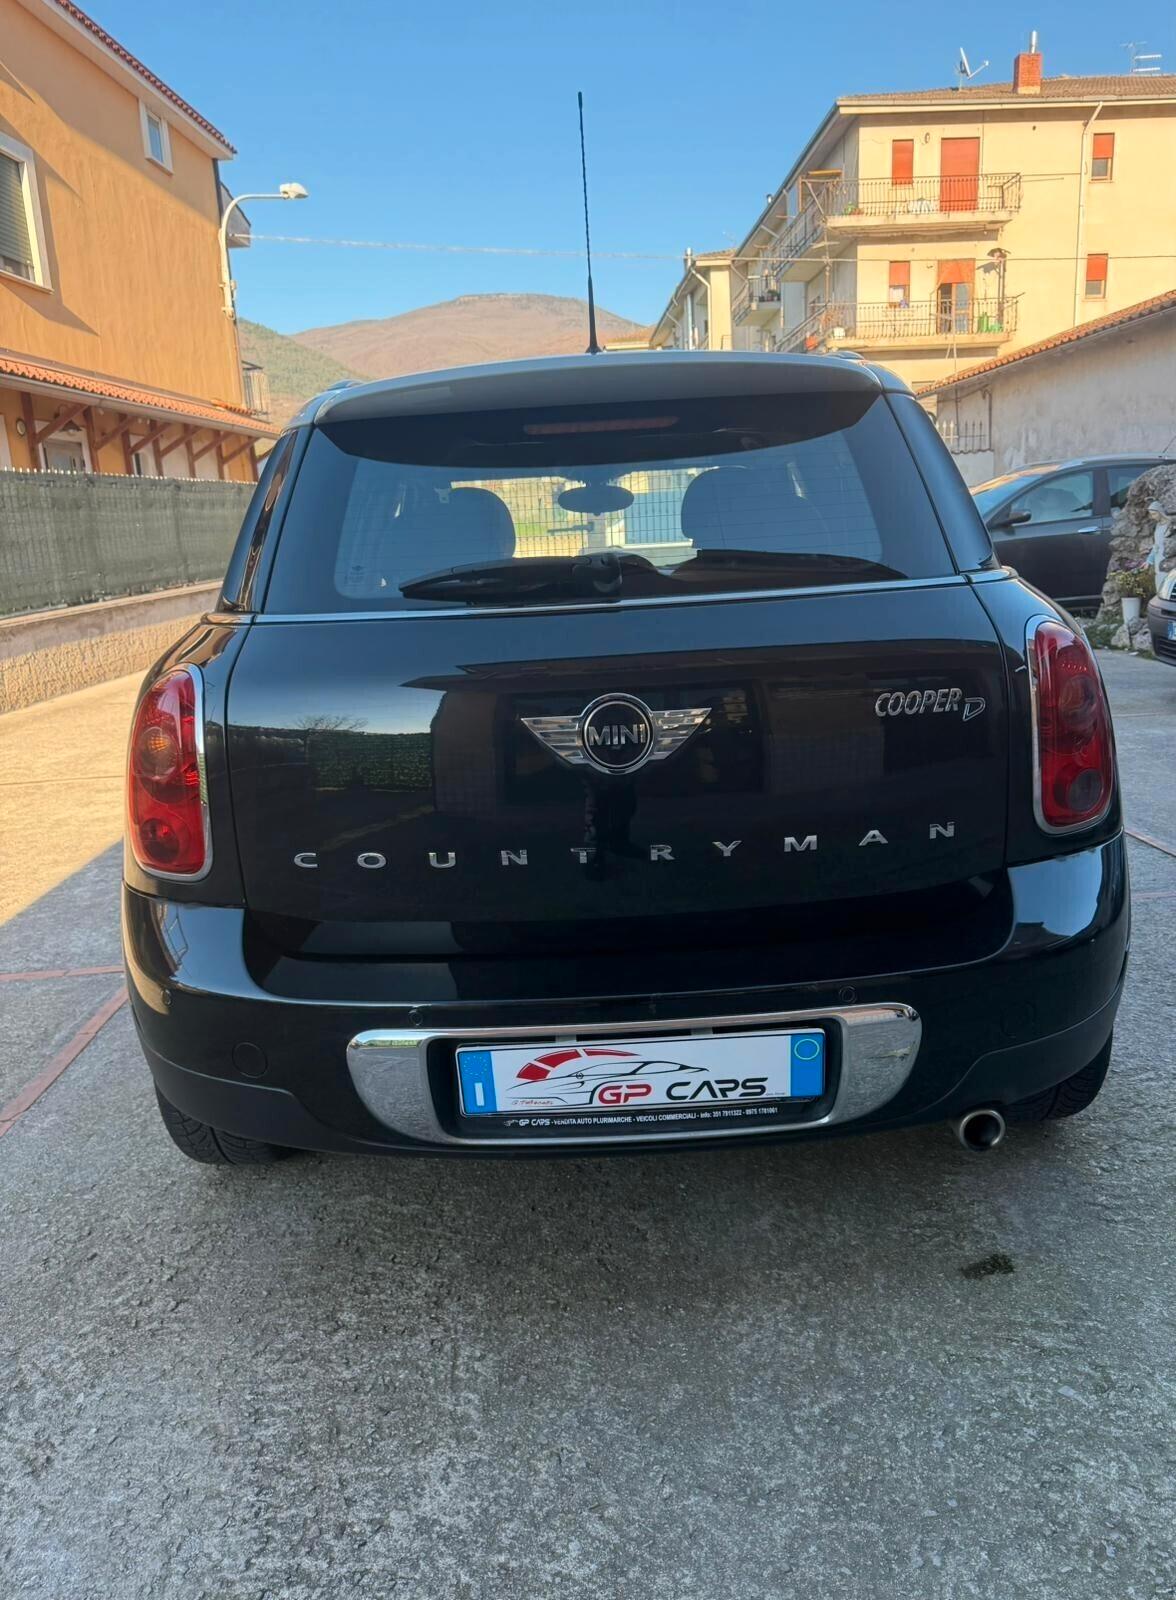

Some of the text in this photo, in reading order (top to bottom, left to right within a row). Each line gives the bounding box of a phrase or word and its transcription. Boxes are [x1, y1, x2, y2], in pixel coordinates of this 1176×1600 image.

[875, 688, 986, 721] COOPER D
[588, 723, 646, 746] MINI
[293, 821, 956, 869] COUNTRYMAN
[597, 1077, 769, 1105] GP CARS
[518, 1118, 529, 1127] GP
[577, 1117, 592, 1125] AUTO
[593, 1115, 632, 1124] PLURIMARCHE
[636, 1114, 658, 1123] VEICOLI
[658, 1112, 697, 1121] COMMERCIALI
